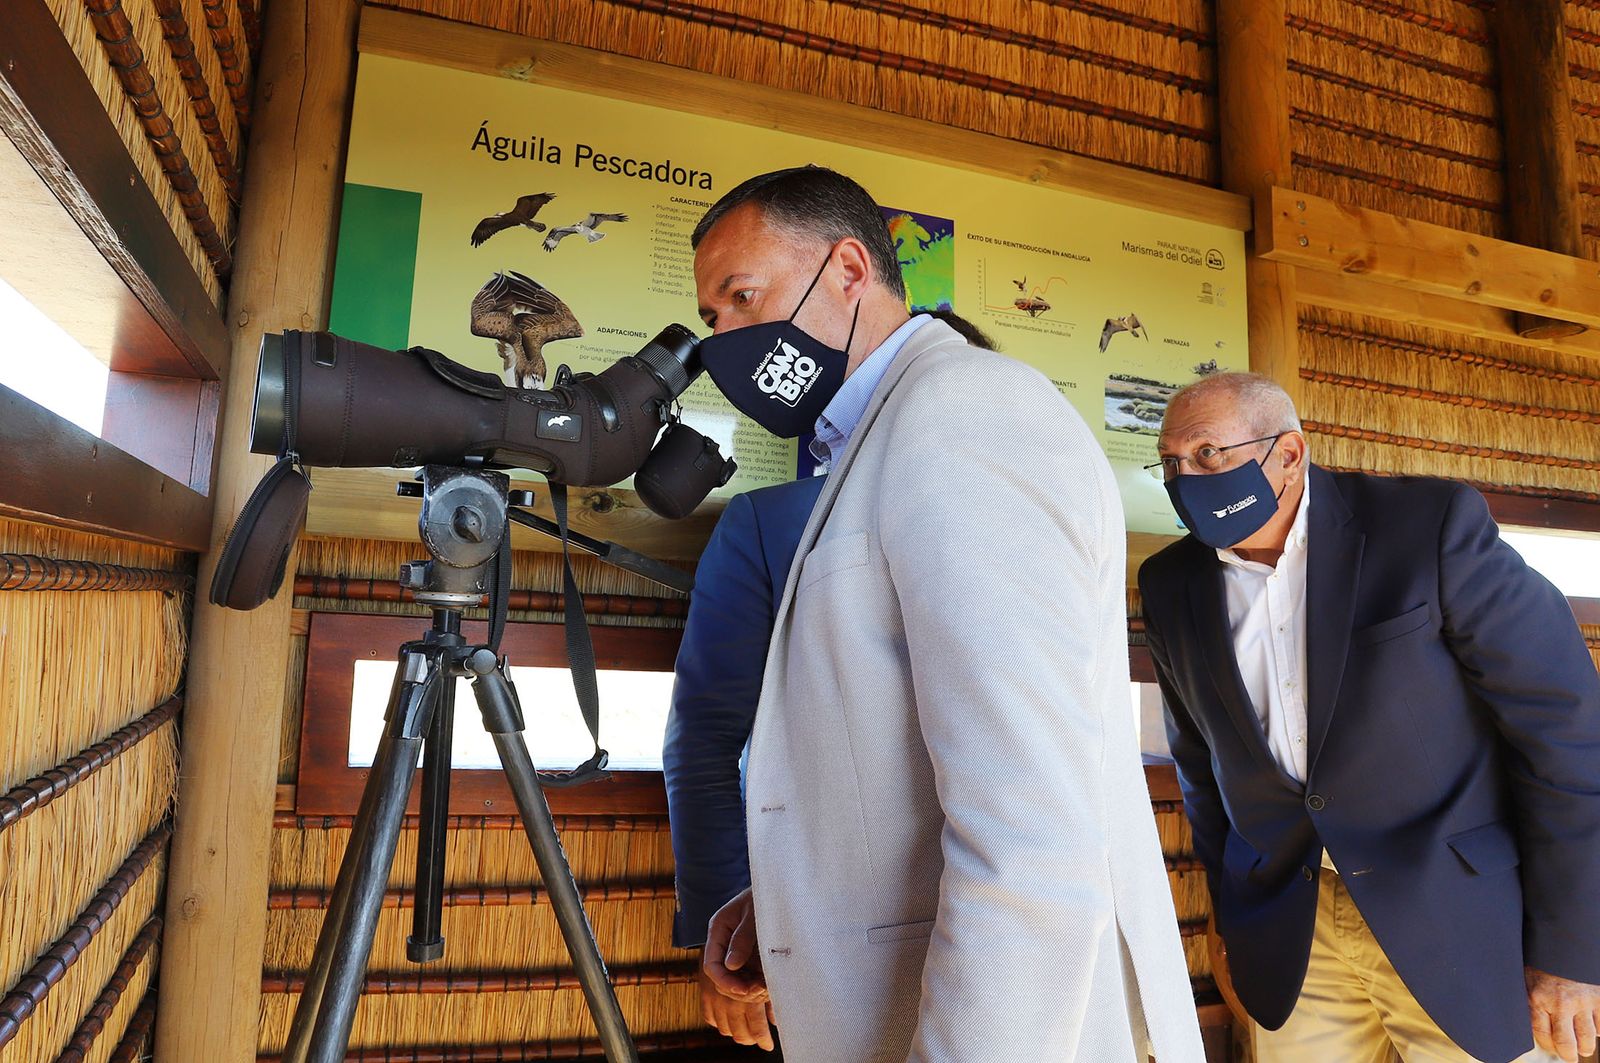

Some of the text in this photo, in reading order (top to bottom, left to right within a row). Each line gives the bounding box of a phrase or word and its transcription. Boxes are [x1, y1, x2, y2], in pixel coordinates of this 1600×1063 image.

[471, 120, 713, 190] Águila Pescadora
[994, 238, 1002, 246] SU
[1003, 240, 1052, 255] REINTRODUCCIÓN
[1052, 249, 1060, 257] EN
[1121, 240, 1203, 267] Marismas del Odiel
[1157, 240, 1202, 256] PARAJE NATURAL
[597, 326, 648, 339] ADAPTACIONES
[1163, 337, 1190, 348] AMENAZAS
[751, 351, 774, 382] Andalucía
[757, 341, 800, 394] CAM
[803, 366, 824, 393] climático
